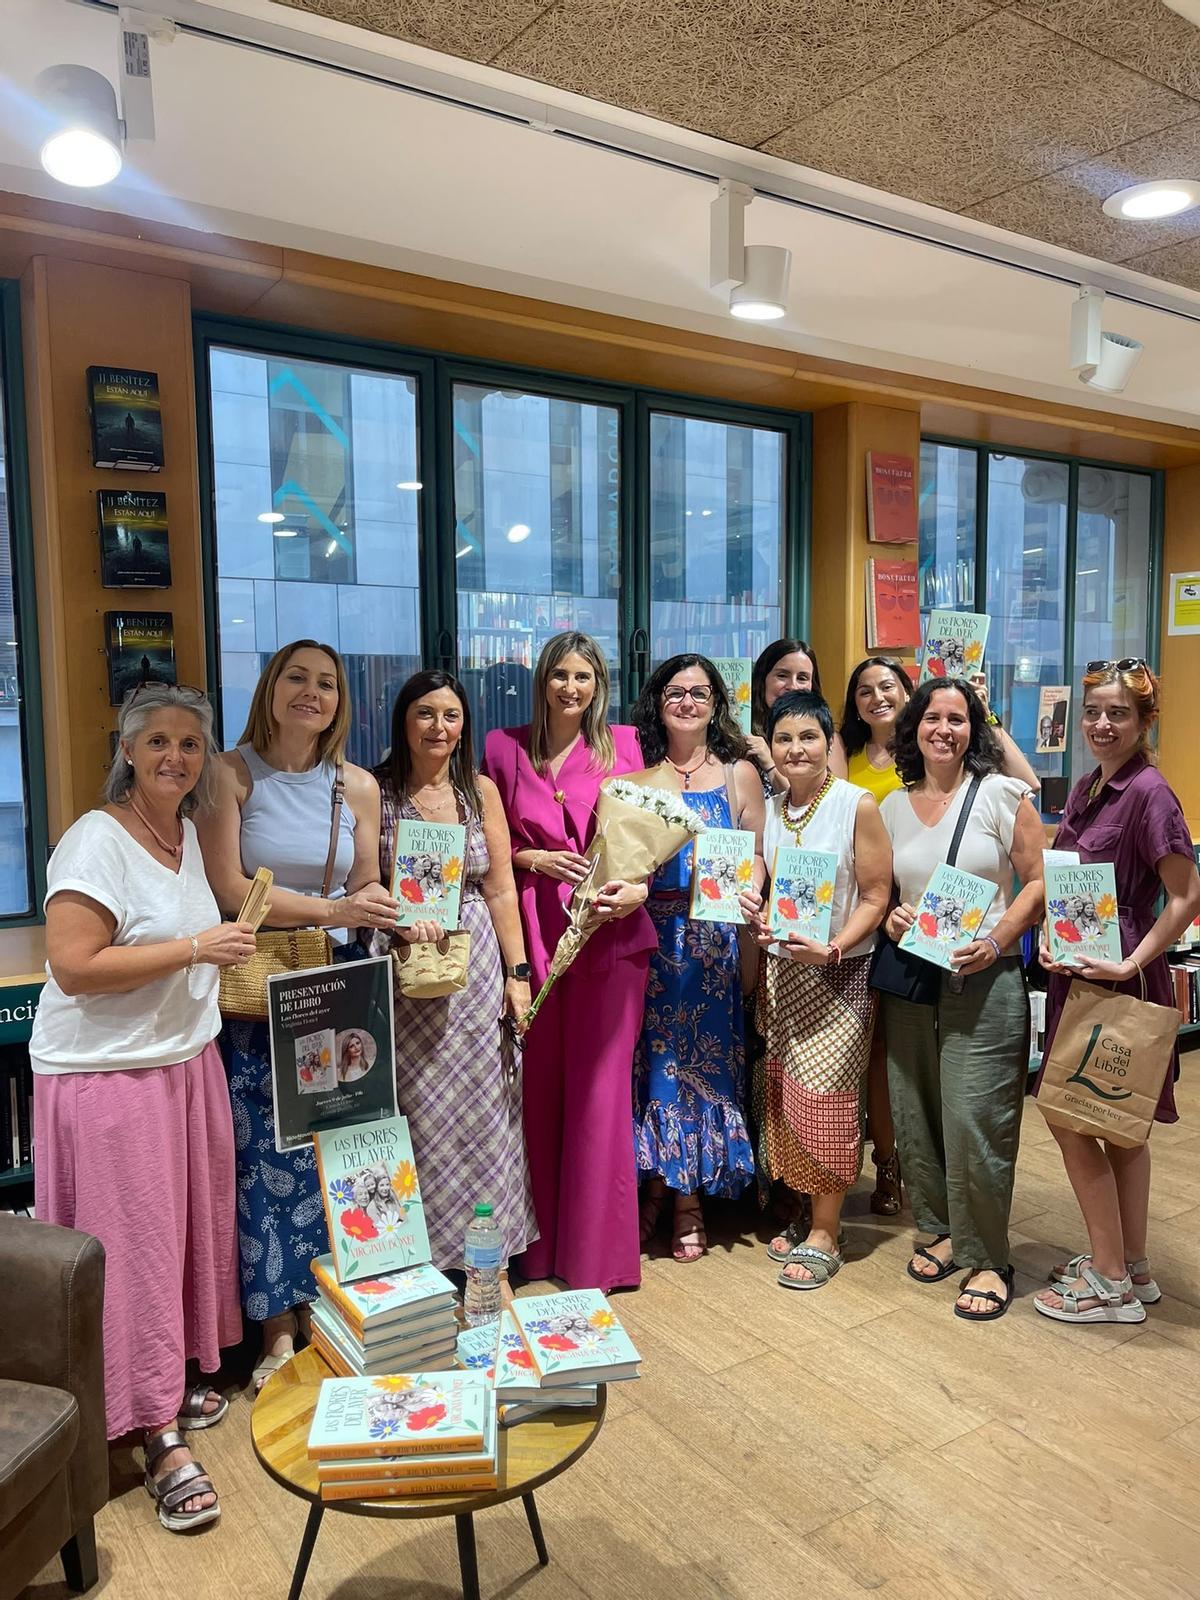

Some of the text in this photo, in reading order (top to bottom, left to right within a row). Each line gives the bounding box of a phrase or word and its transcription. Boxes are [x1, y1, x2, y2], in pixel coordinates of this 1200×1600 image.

[938, 617, 979, 629] LAS FLORES
[940, 626, 974, 639] DEL AYER
[408, 828, 456, 844] LAS FLORES
[706, 833, 748, 847] LAS FLORES
[411, 840, 451, 855] DEL AYER
[709, 844, 744, 857] DEL AYER
[786, 854, 829, 869] LAS FLORES
[788, 865, 824, 879] DEL AYER
[1054, 870, 1104, 882] LAS FLORES
[941, 872, 985, 895] LAS FLORES
[1059, 882, 1100, 895] DEL AYER
[940, 882, 978, 904] DEL AYER
[279, 977, 346, 1001] PRESENTACIÓN
[0, 1000, 40, 1022] nci
[280, 996, 321, 1013] DE LIBRO
[1101, 1038, 1132, 1057] Casa
[1094, 1057, 1127, 1077] Libro
[1113, 1056, 1130, 1068] del
[1064, 1094, 1092, 1109] Gracias
[1093, 1105, 1107, 1115] por
[1107, 1110, 1123, 1121] leer
[334, 1127, 398, 1152] LAS FLORES
[342, 1147, 395, 1169] DEL AYER
[350, 1239, 387, 1258] VIRGINIA
[527, 1293, 592, 1309] LAS FLORES
[536, 1303, 590, 1317] DEL AYER
[325, 1386, 351, 1432] LAS FLORES
[343, 1388, 368, 1427] DEL AYER
